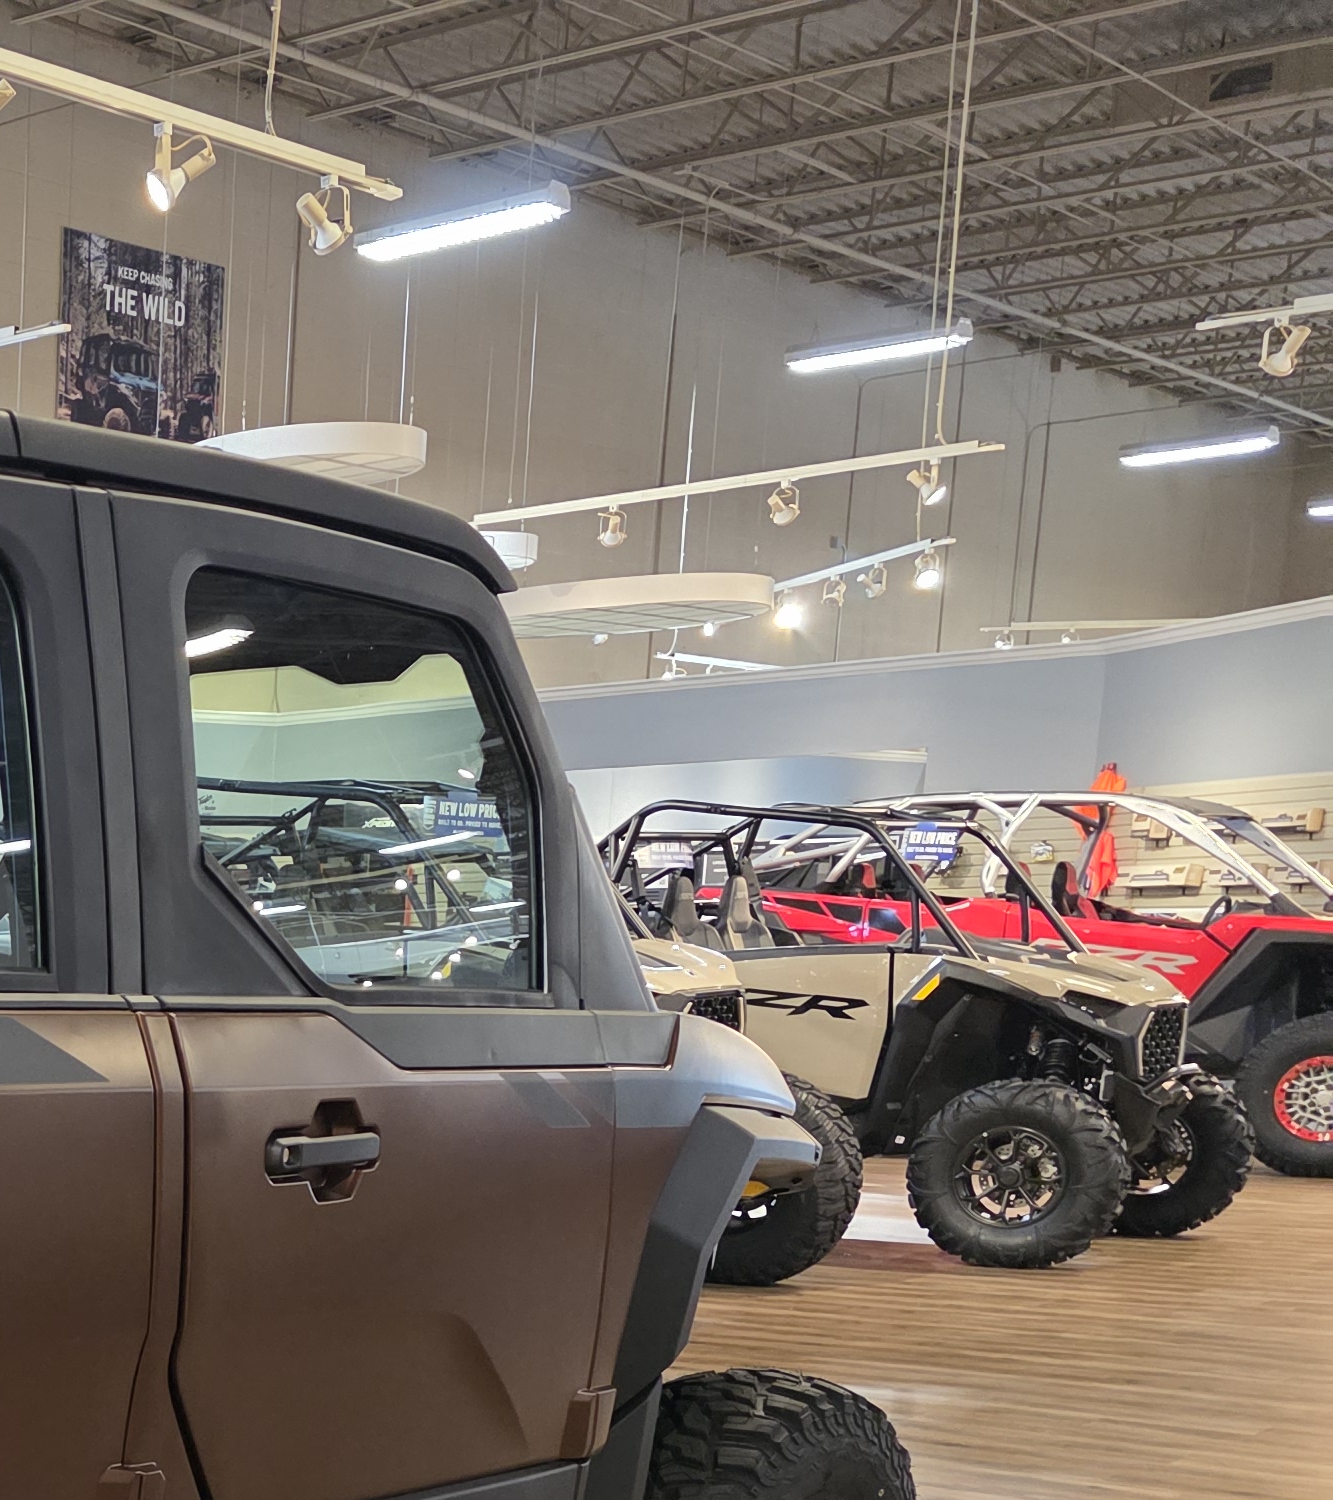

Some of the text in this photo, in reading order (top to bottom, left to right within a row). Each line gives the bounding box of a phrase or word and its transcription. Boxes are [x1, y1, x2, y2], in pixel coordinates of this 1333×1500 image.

[118, 265, 139, 281] KEEP
[103, 283, 186, 327] THE WILD
[439, 801, 458, 816] NEW
[458, 802, 478, 818] LOW
[478, 803, 501, 819] PRIC
[746, 988, 870, 1020] ZR
